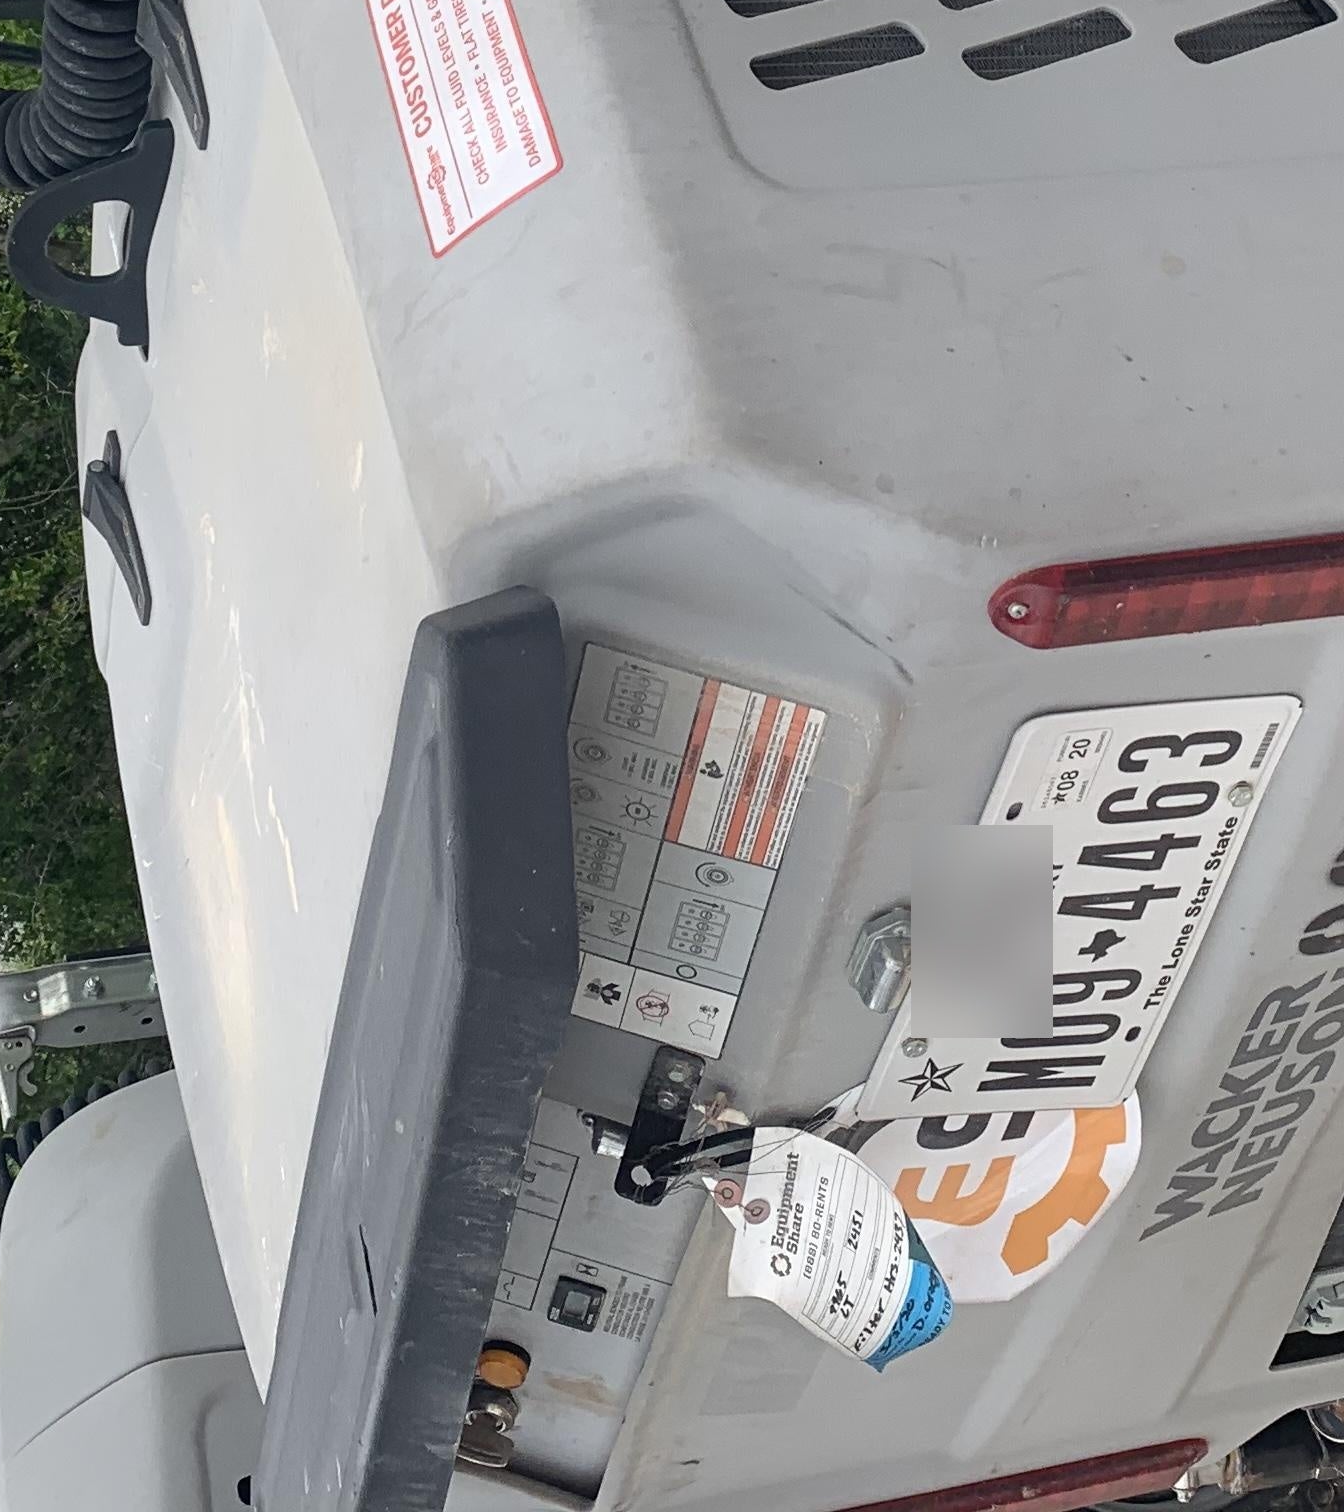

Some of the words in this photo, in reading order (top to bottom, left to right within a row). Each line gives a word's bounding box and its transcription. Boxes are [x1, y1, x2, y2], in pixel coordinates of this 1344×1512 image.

[429, 10, 443, 22] &
[435, 21, 460, 70] LEVELS
[460, 30, 480, 60] FLAT
[481, 9, 515, 86] EQUIPMENT
[384, 8, 433, 138] CUSTOMER
[446, 70, 470, 109] FLUID
[503, 86, 521, 108] TO
[456, 109, 477, 134] ALL
[475, 73, 508, 153] INSURANCE
[512, 109, 542, 168] DAMAGE
[467, 137, 491, 186] CHECK
[1068, 738, 1091, 760] 20
[1057, 770, 1080, 791] 08
[1057, 729, 1243, 922] 4463
[1143, 971, 1172, 1011] The
[1162, 924, 1194, 970] Lone
[1185, 876, 1213, 921] Star
[1204, 815, 1238, 871] State
[1139, 970, 1329, 1242] WACKER
[771, 1151, 800, 1250] Equipment
[786, 1202, 804, 1255] Share
[804, 1243, 818, 1279] (888)
[812, 1176, 829, 1240] 80-RENTS
[848, 1210, 863, 1250] 2451
